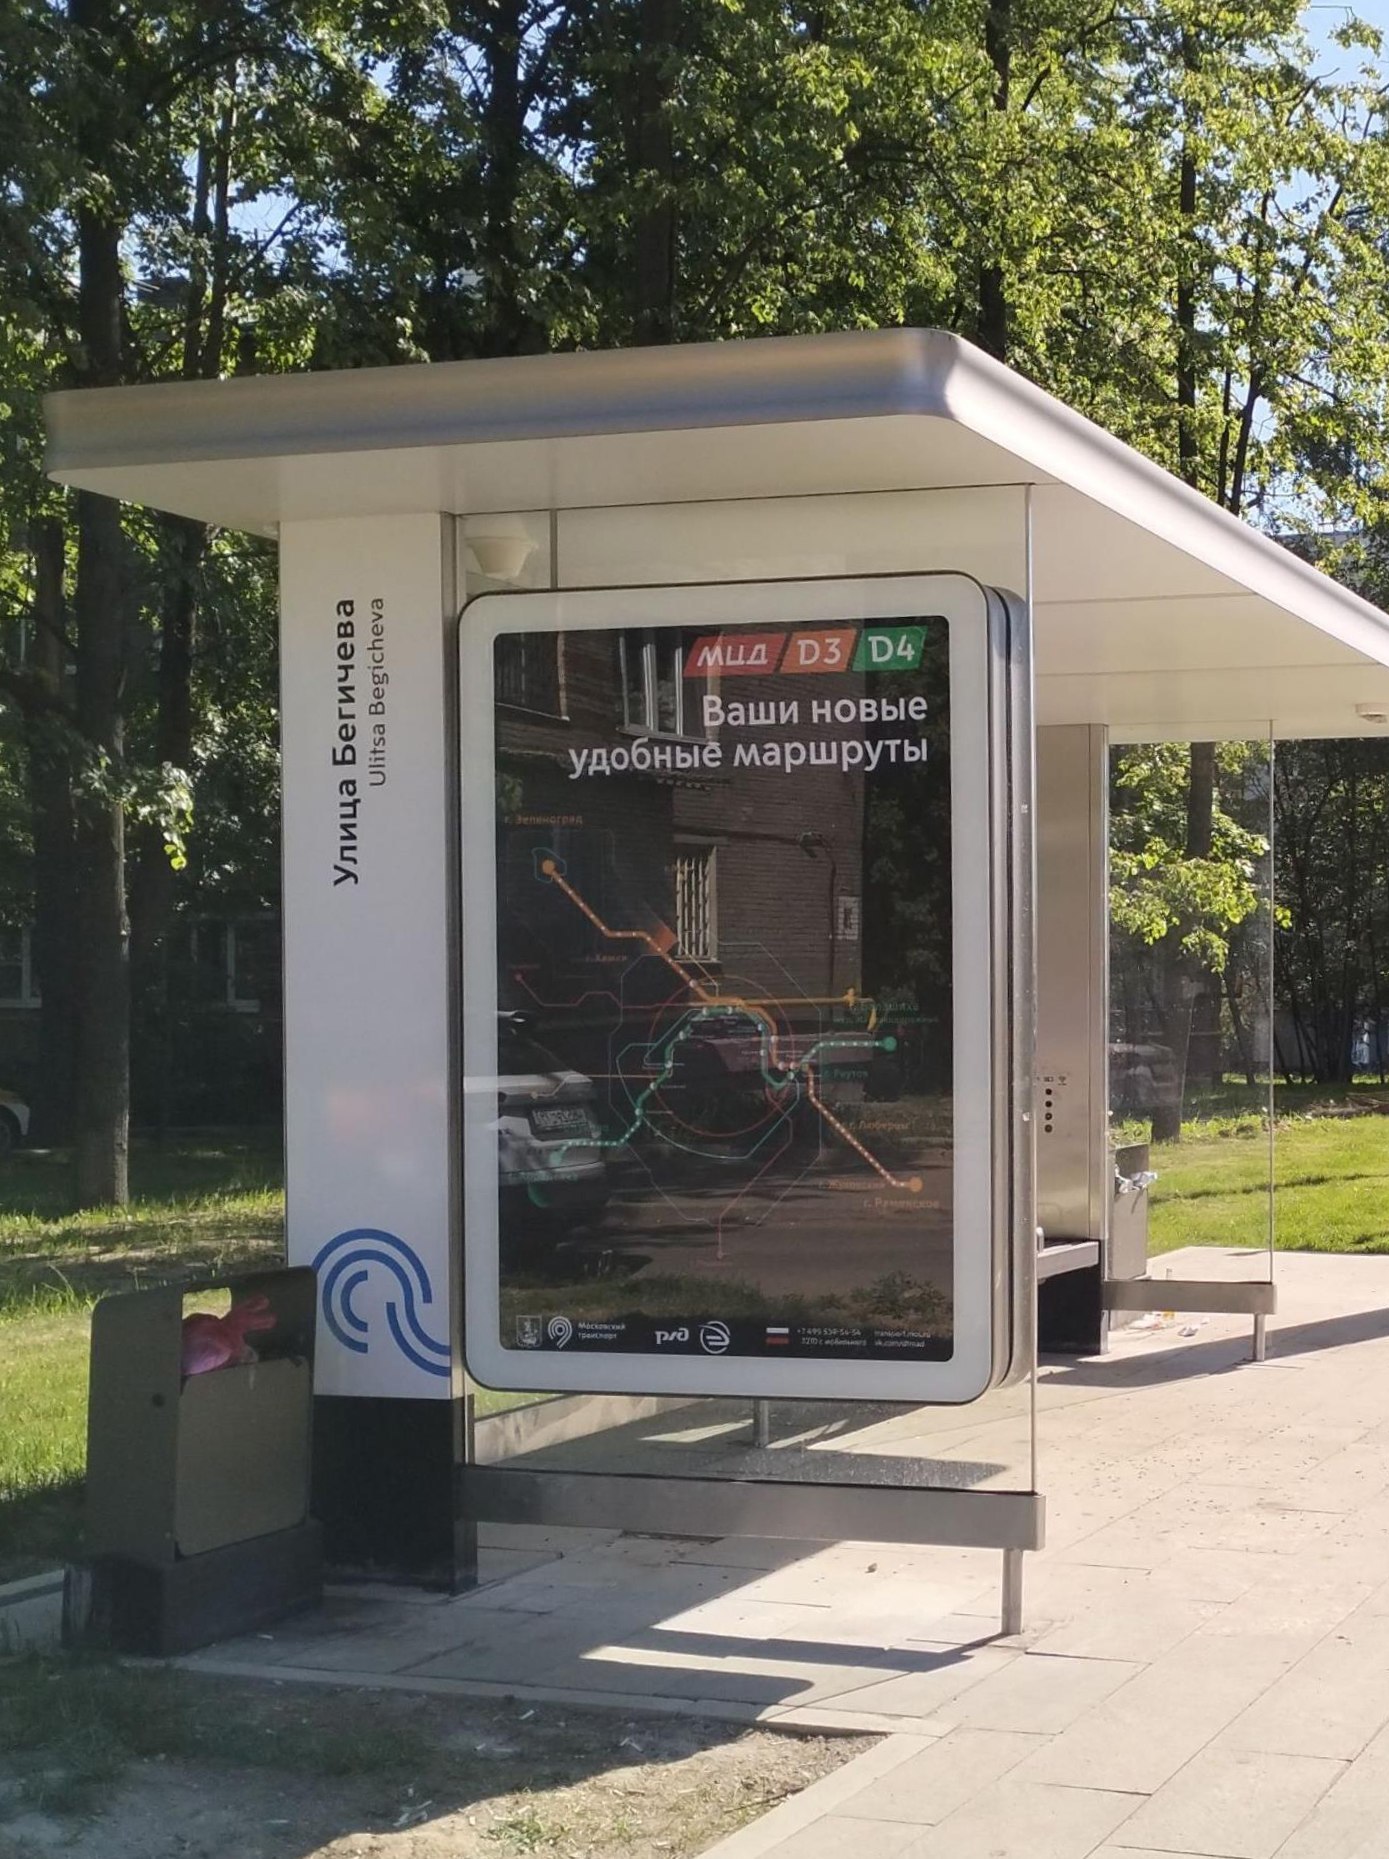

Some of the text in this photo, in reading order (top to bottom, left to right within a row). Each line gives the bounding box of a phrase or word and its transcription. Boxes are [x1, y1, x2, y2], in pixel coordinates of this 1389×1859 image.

[797, 638, 841, 665] D3
[868, 635, 915, 662] D4
[367, 598, 389, 787] Ulitsa Begicheva
[703, 694, 928, 727] Ваши новые
[332, 599, 361, 886] Улица Бегичева
[568, 737, 928, 779] удобные маршруты
